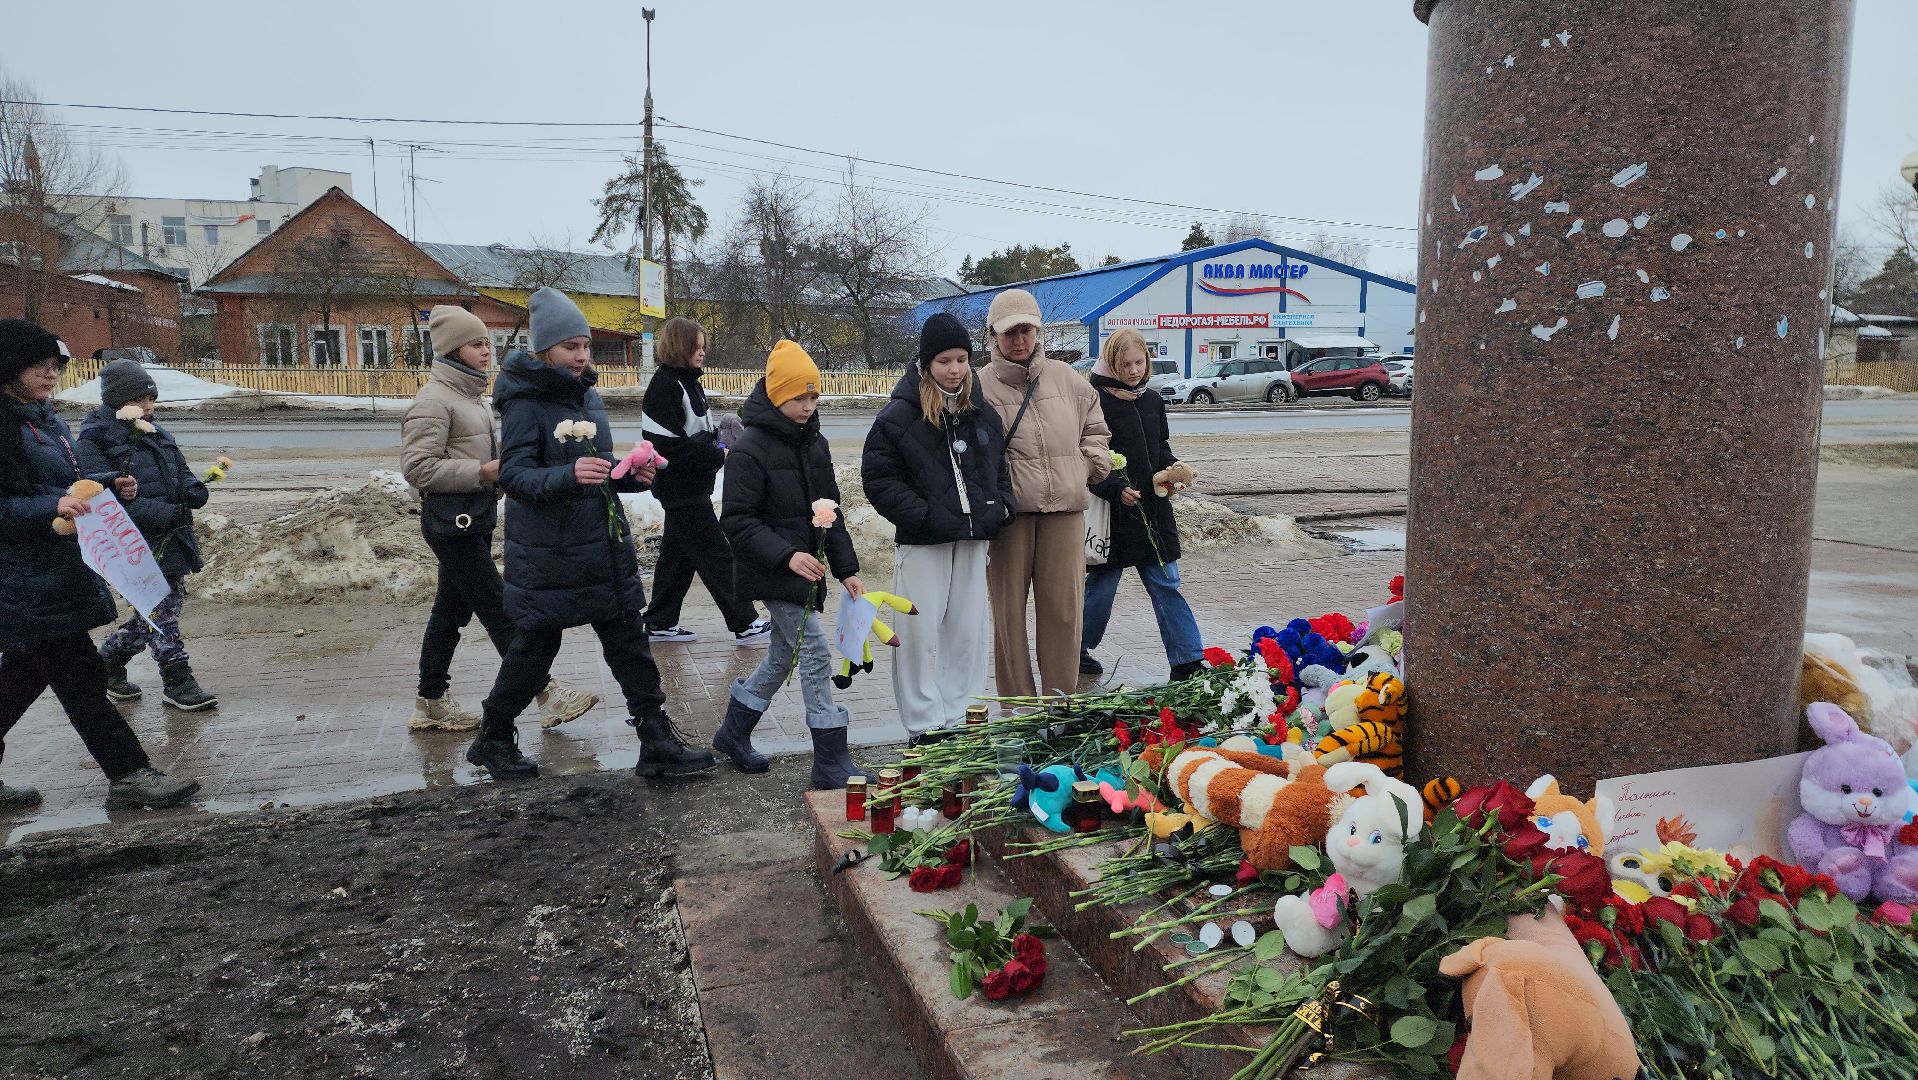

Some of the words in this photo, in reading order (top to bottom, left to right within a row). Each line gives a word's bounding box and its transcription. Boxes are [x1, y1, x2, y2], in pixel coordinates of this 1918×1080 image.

[1203, 263, 1245, 279] АКВА
[1249, 263, 1310, 279] МАСТЕР
[1160, 315, 1267, 328] НЕДОРОГАЯ-МЕБЕЛЬ.РФ
